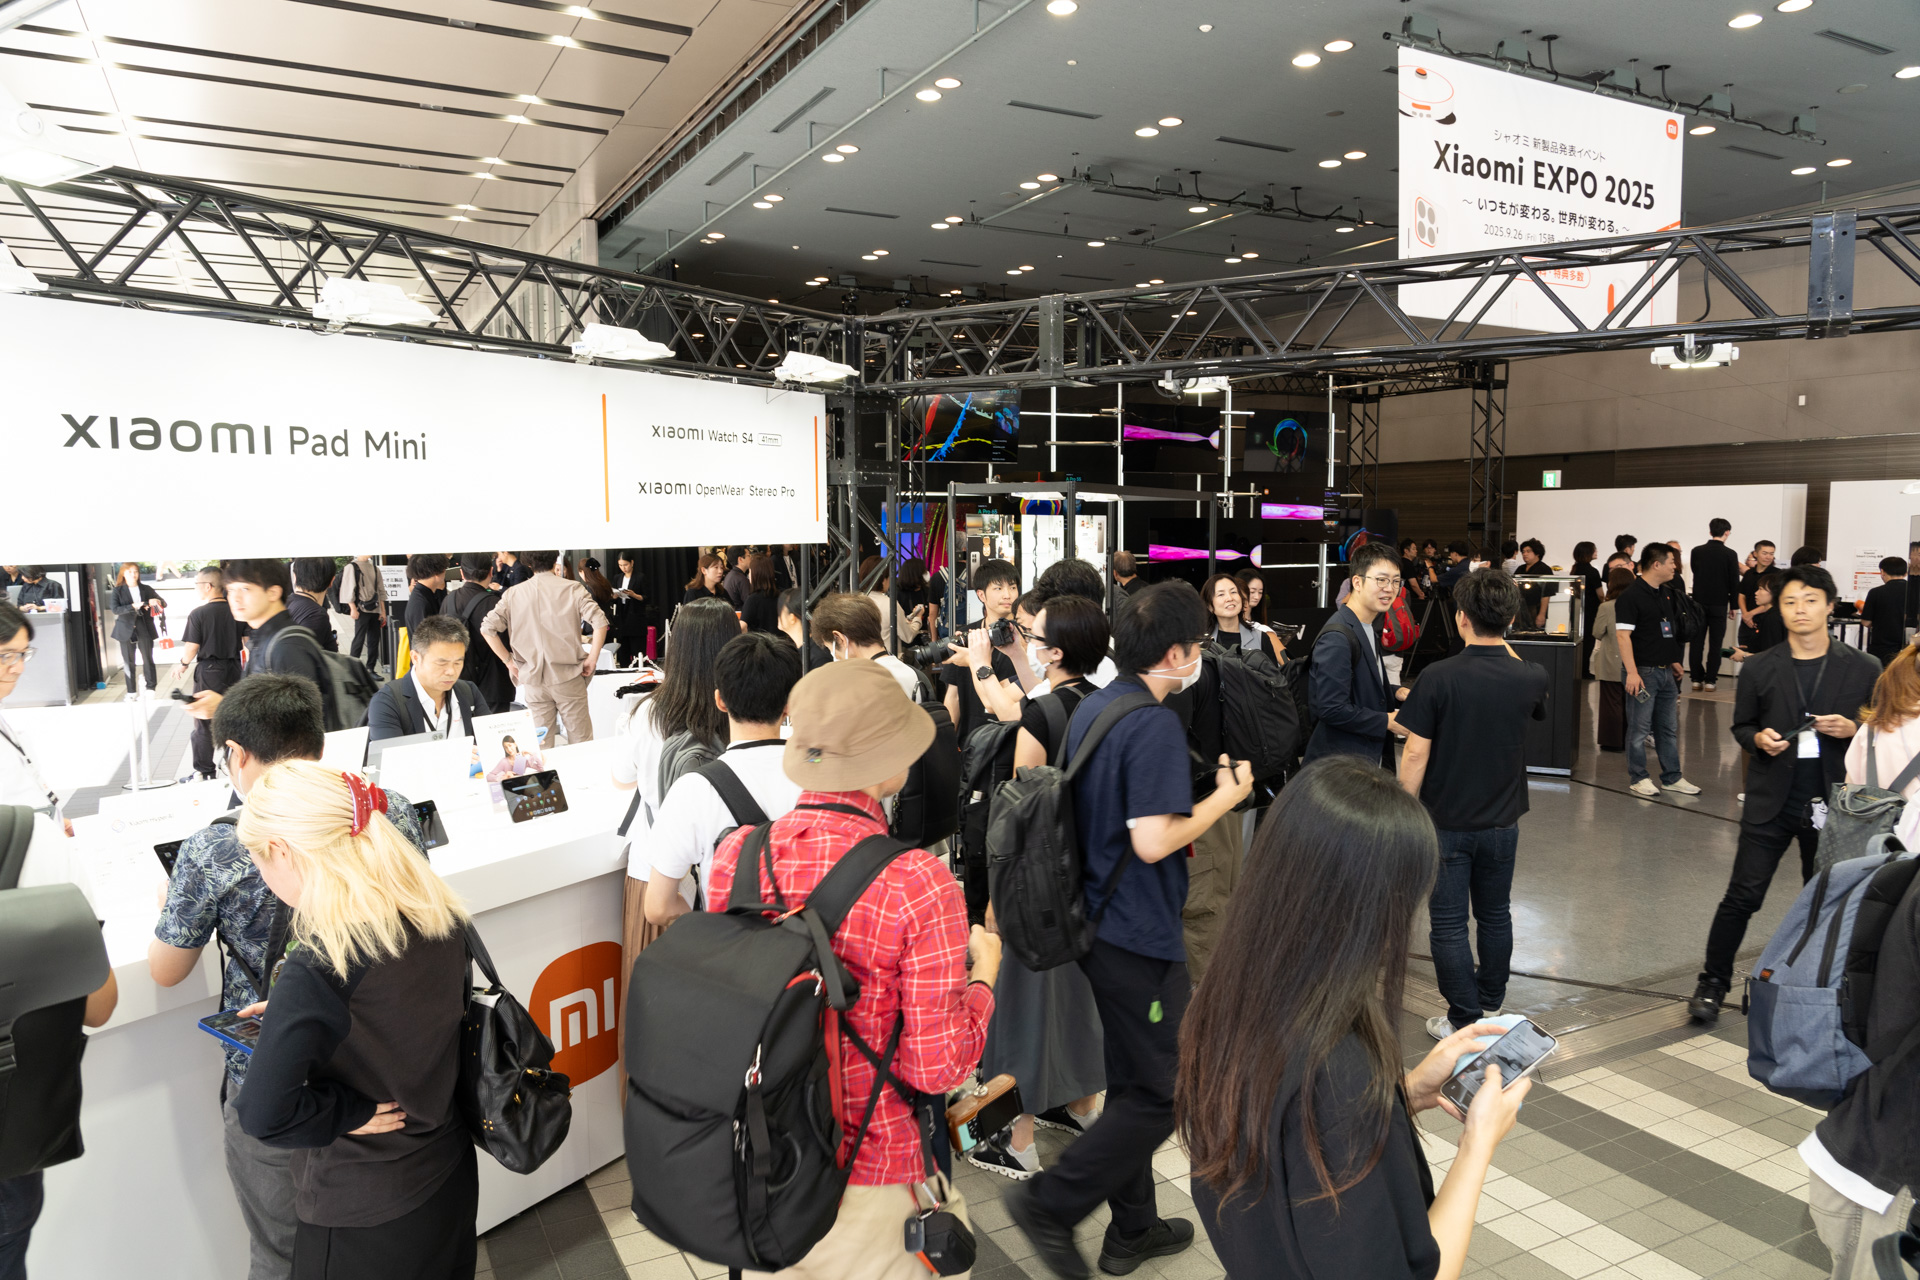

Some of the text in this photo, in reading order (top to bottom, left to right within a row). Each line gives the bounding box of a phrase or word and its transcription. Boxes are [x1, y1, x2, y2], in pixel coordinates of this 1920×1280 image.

[1494, 129, 1606, 162] シャオミ 新製品発表イベント
[1433, 140, 1655, 210] Xiaomi EXPO 2025
[1484, 224, 1523, 240] 2025.9.26
[289, 426, 348, 457] Pad
[364, 430, 426, 460] Mini
[708, 430, 738, 442] Watch
[742, 432, 754, 444] S4
[762, 436, 778, 444] 41mm
[696, 484, 745, 498] OpenWear
[749, 484, 778, 498] Stereo
[781, 486, 796, 498] Pro
